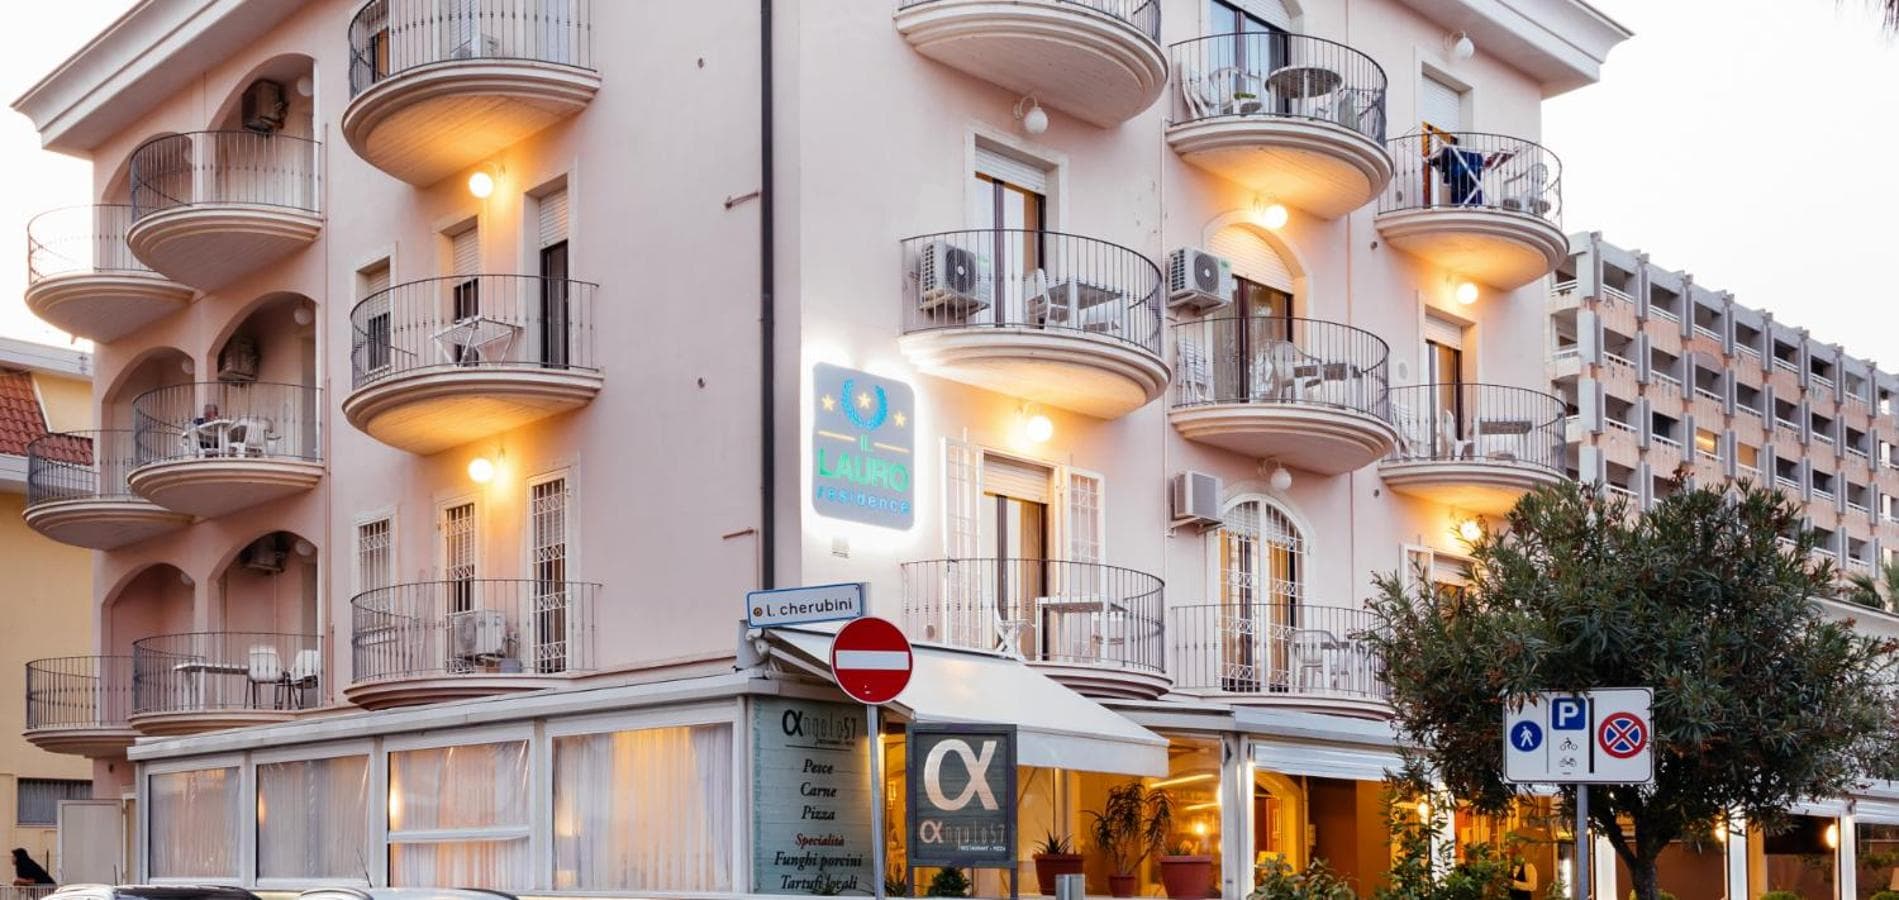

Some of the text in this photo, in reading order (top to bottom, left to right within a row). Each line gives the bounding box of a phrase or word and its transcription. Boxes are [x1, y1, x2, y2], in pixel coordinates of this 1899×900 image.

[861, 434, 874, 452] IL
[817, 447, 910, 493] LAURO
[816, 486, 910, 515] residence
[780, 598, 852, 615] cherubini
[1559, 702, 1579, 727] P
[802, 758, 834, 774] Pesce
[800, 782, 837, 798] Carne
[801, 805, 836, 820] Pizza
[774, 851, 863, 871] Funghi porcini
[781, 874, 824, 889] Tartufi
